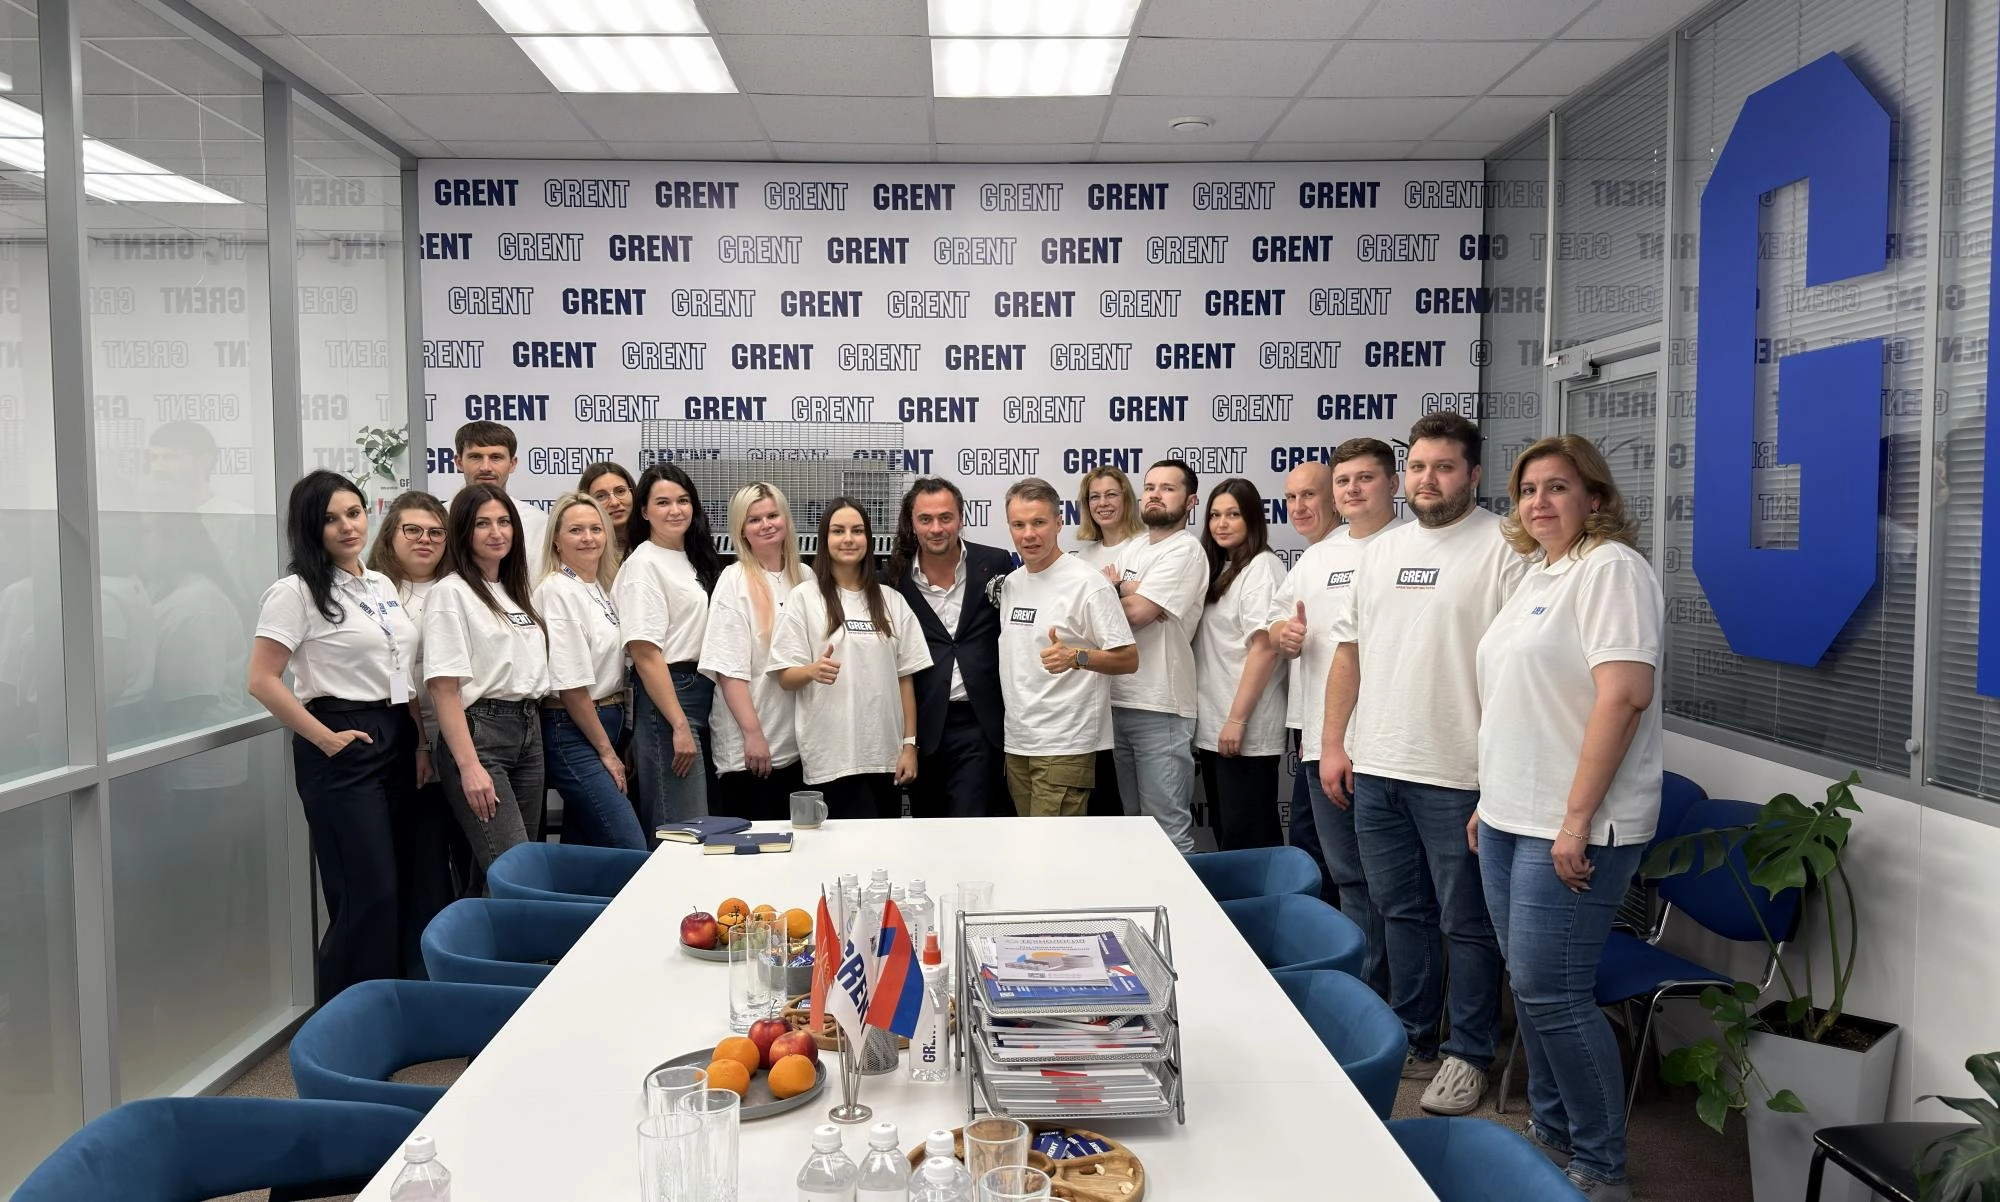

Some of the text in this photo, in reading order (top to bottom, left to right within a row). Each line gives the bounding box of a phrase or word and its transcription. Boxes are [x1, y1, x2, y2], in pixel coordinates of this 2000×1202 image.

[434, 179, 1485, 211] GRENT GRENT GRENT GRENT GRENT GRENT GRENT GRENT GRENT GRENT
[419, 233, 473, 260] ENT
[498, 232, 584, 261] GRENT
[609, 234, 693, 262] GRENT
[718, 235, 803, 264] GRENT
[827, 237, 910, 264] GRENT
[934, 237, 1017, 265] GRENT
[1041, 237, 1123, 264] GRENT
[1146, 236, 1228, 264] GRENT
[1252, 235, 1333, 262] GRENT
[1357, 234, 1439, 261] GRENT
[448, 287, 1483, 318] GRENT GRENT GRENT GRENT GRENT GRENT GRENT GRENT GRENT GREN
[423, 340, 485, 369] RENT
[512, 341, 597, 369] GRENT
[622, 341, 707, 370] GRENT
[731, 343, 814, 370] GRENT
[838, 343, 921, 371] GRENT
[945, 344, 1027, 371] GRENT
[1050, 343, 1133, 371] GRENT
[1156, 343, 1236, 370] GRENT
[1259, 341, 1341, 369] GRENT
[1365, 340, 1446, 367] GRENT
[465, 394, 550, 421] GRENT
[574, 394, 660, 422] GRENT
[684, 396, 767, 421] GRENT
[791, 396, 875, 423] GRENT
[898, 396, 980, 423] GRENT
[1003, 396, 1085, 423] GRENT
[1109, 395, 1189, 422] GRENT
[1212, 394, 1293, 422] GRENT
[1317, 393, 1398, 420] GRENT
[528, 447, 613, 475] GRENT
[957, 448, 1039, 475] GRENT
[1063, 448, 1143, 474] GRENT
[1270, 446, 1336, 473] GREN
[1330, 571, 1354, 584] GREN
[1400, 570, 1436, 584] GRENT
[360, 601, 375, 616] GRENT
[1012, 609, 1035, 622] GRENT
[837, 939, 870, 1037] REN
